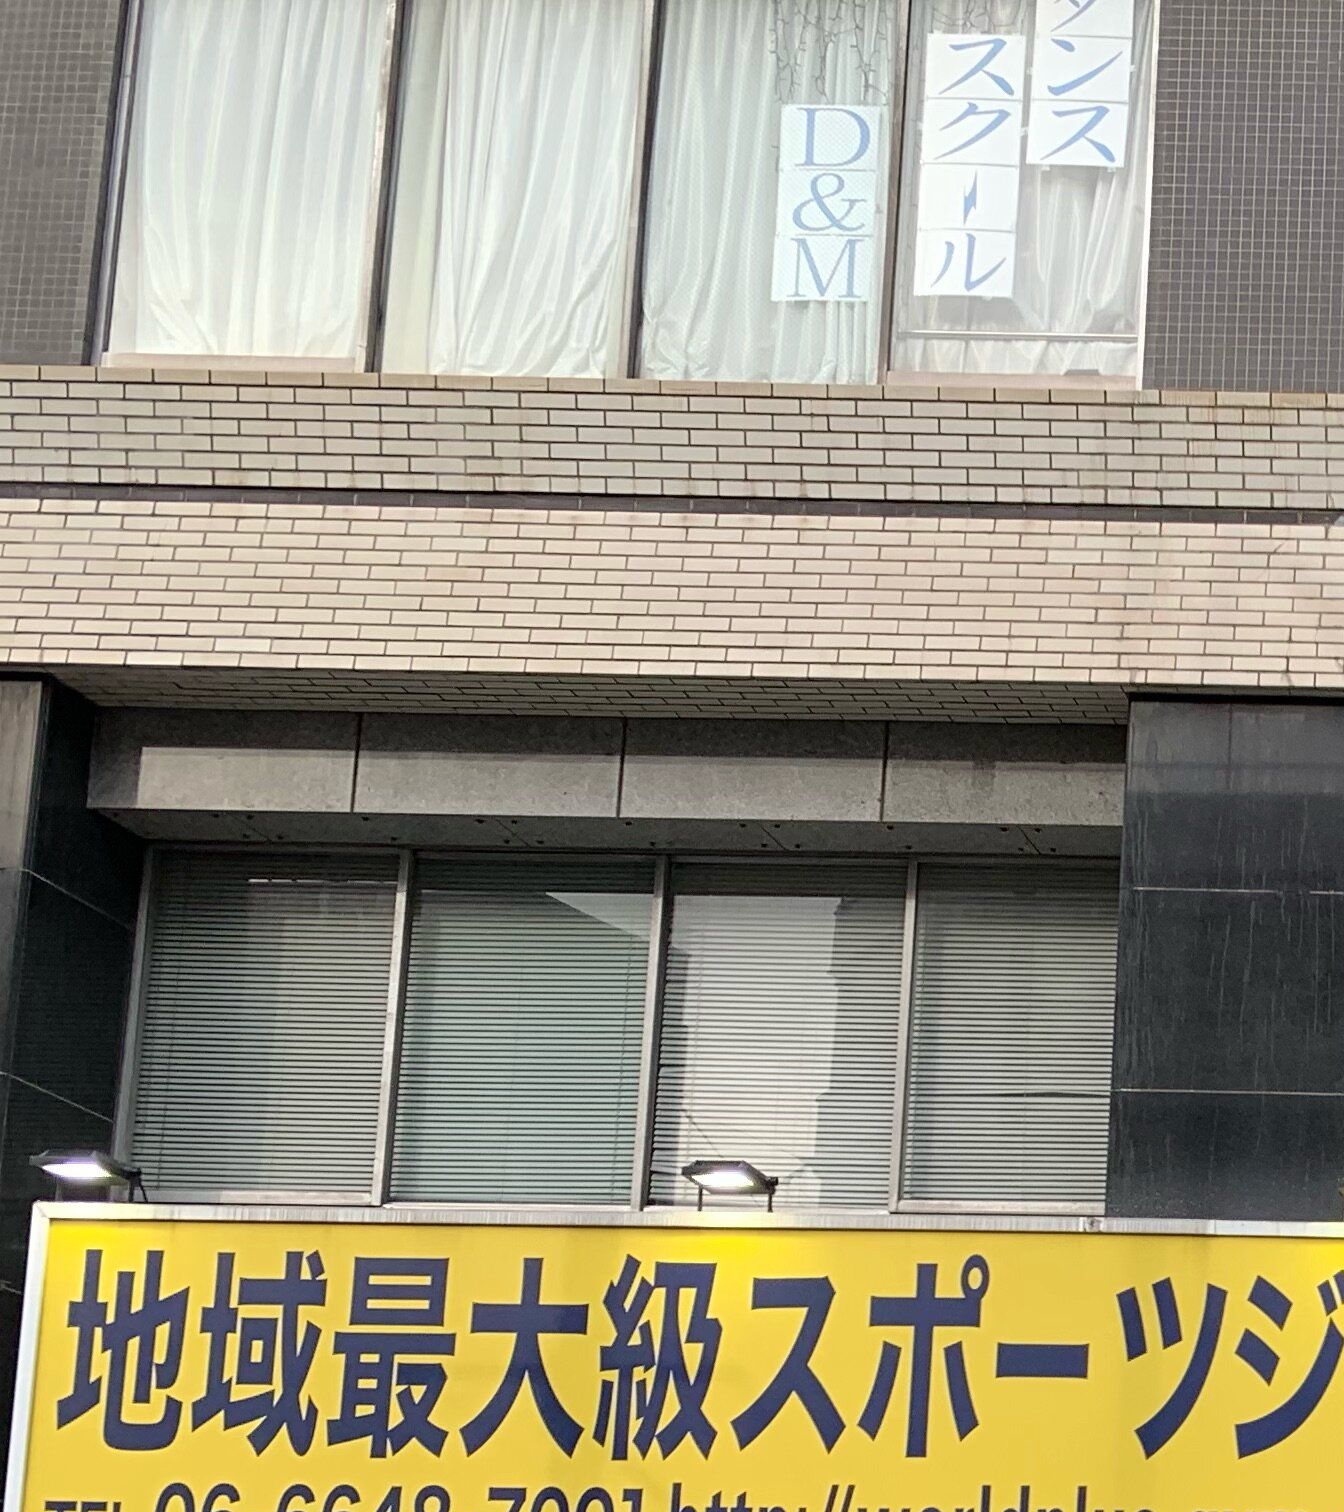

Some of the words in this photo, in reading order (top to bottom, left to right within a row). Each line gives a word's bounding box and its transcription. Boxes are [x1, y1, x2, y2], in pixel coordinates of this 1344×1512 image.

[790, 106, 871, 299] D&M
[930, 37, 1014, 292] スクール
